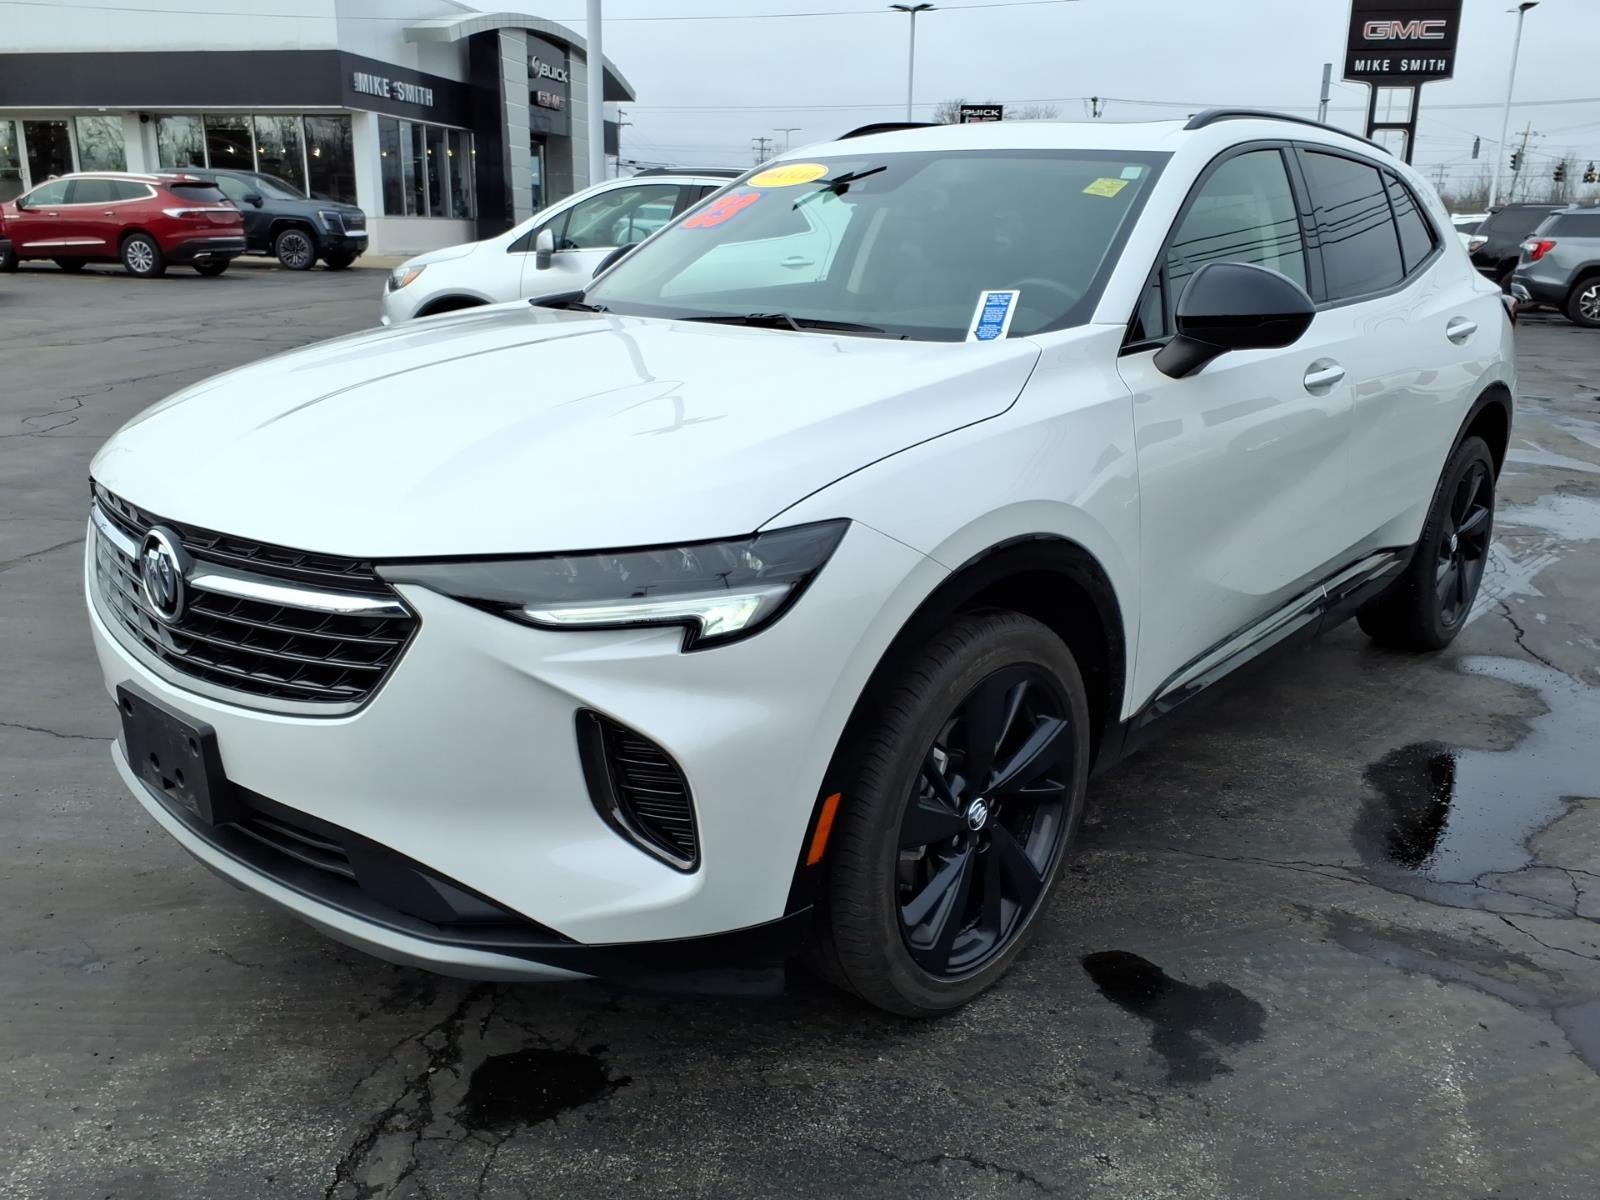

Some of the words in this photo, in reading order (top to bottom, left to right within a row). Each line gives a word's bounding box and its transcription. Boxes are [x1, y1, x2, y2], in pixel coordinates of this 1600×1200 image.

[1363, 20, 1447, 40] GMC
[540, 62, 568, 83] BUICK
[1354, 59, 1391, 72] MIKE
[1400, 59, 1446, 72] SMITH
[354, 72, 391, 98] MIKE
[394, 80, 433, 107] SMITH
